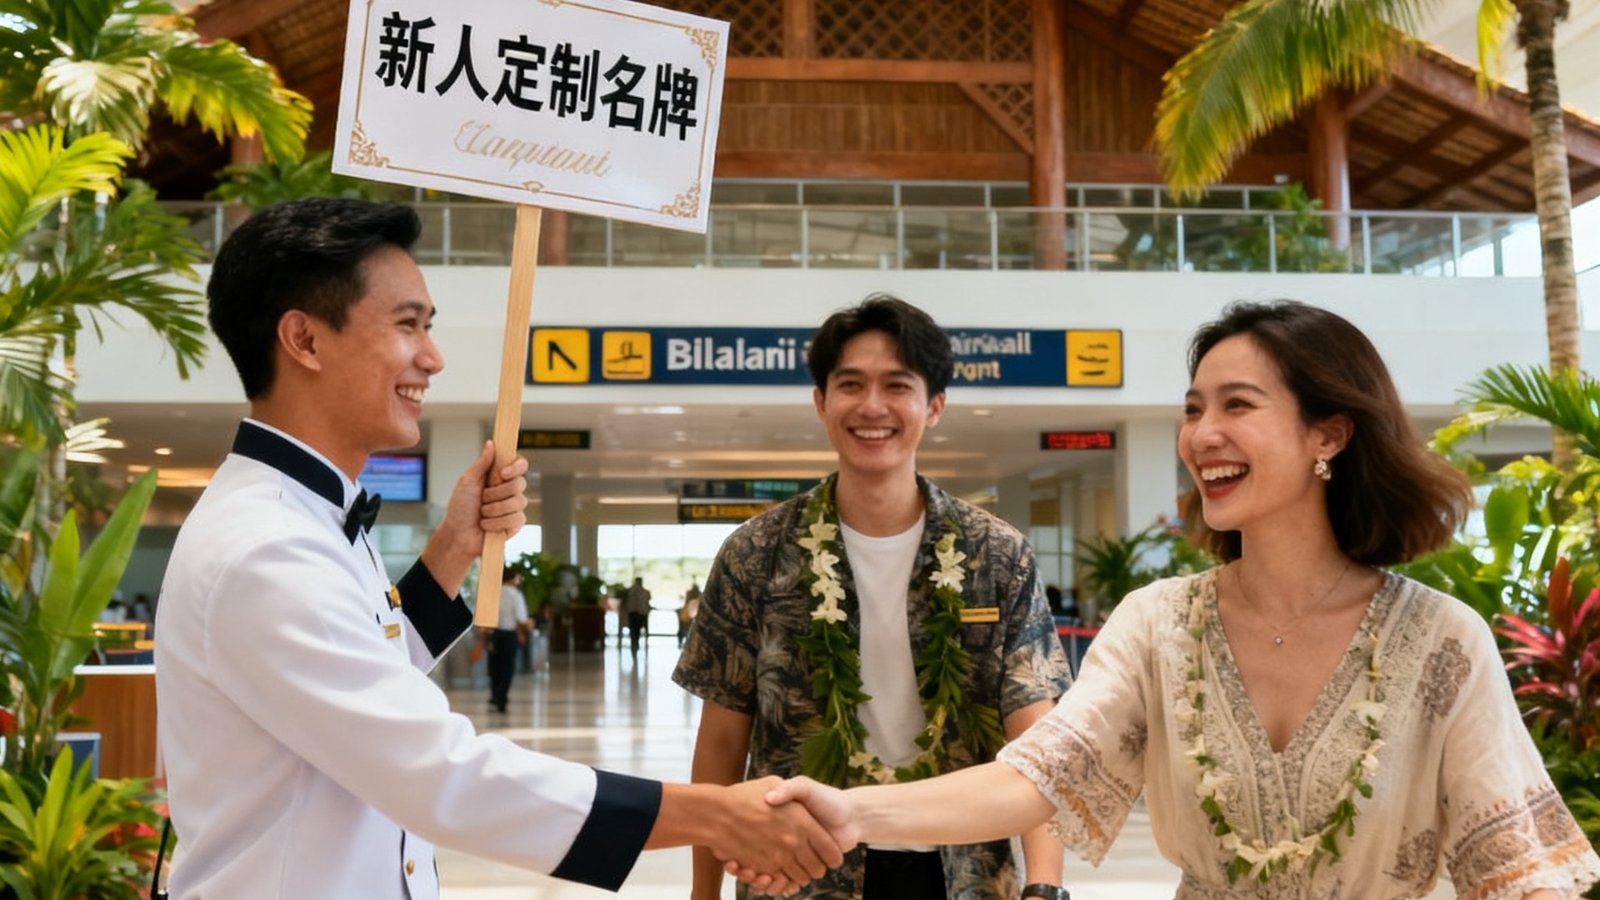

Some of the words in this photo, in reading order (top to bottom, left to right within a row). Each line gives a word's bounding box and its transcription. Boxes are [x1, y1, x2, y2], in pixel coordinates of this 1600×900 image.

[375, 11, 699, 141] 新人定制名牌
